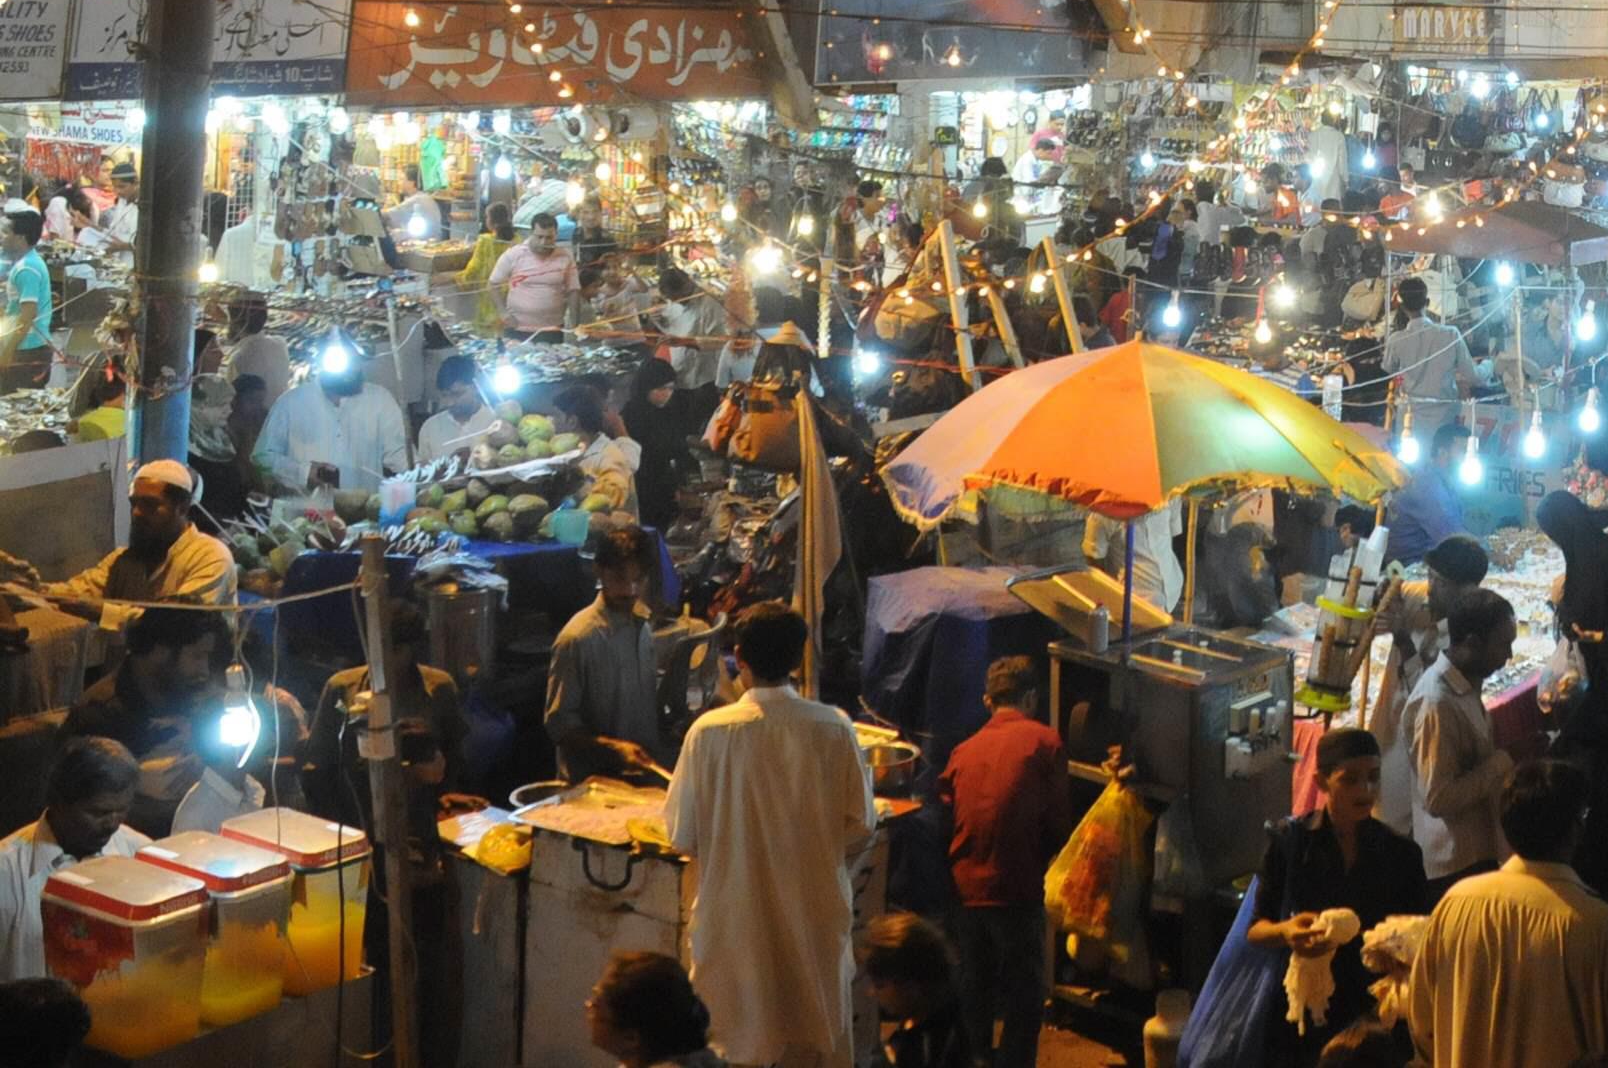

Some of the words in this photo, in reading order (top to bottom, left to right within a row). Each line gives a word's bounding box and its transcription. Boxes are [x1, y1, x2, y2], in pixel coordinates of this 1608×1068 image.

[6, 24, 57, 43] SHOES
[284, 66, 300, 82] 10
[92, 129, 124, 143] SHOES
